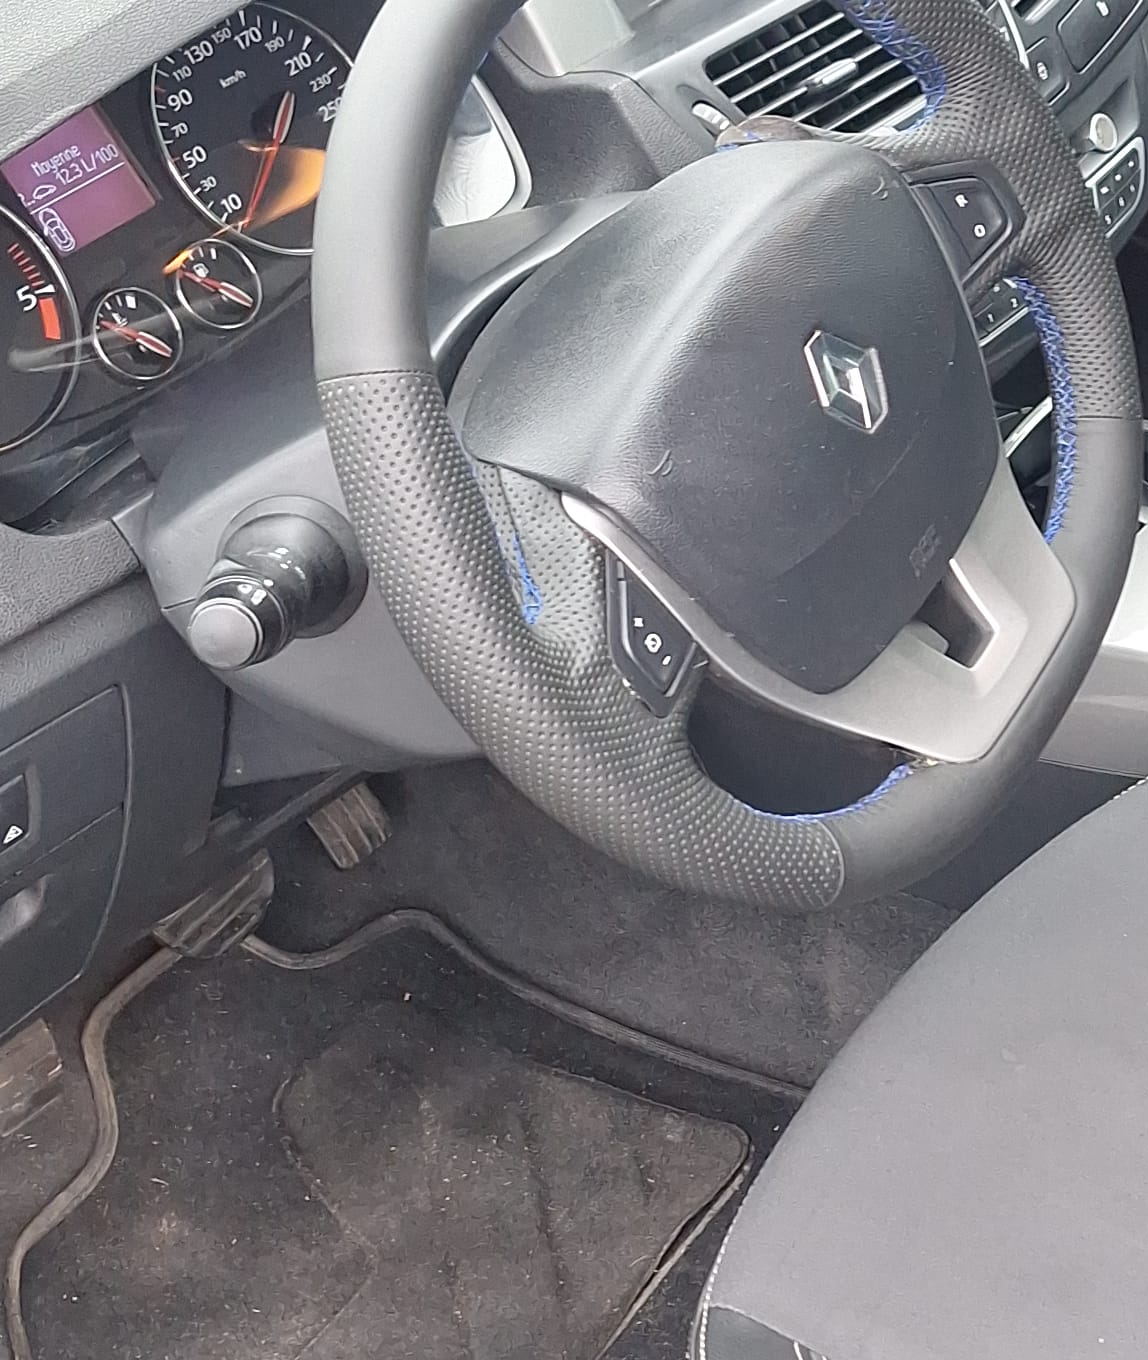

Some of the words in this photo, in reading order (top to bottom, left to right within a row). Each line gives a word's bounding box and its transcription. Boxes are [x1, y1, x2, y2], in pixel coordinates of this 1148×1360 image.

[211, 27, 232, 44] 150
[233, 26, 263, 50] 170
[264, 36, 285, 53] 190
[183, 41, 214, 65] 130
[172, 65, 192, 82] 110
[284, 51, 312, 77] 210
[219, 69, 247, 89] km/h
[309, 73, 332, 92] 230
[167, 89, 193, 112] 90
[171, 122, 189, 138] 70
[30, 145, 81, 177] Moyenne
[182, 146, 207, 169] 50
[200, 176, 217, 192] 30
[220, 193, 242, 213] 10
[16, 285, 38, 312] 5
